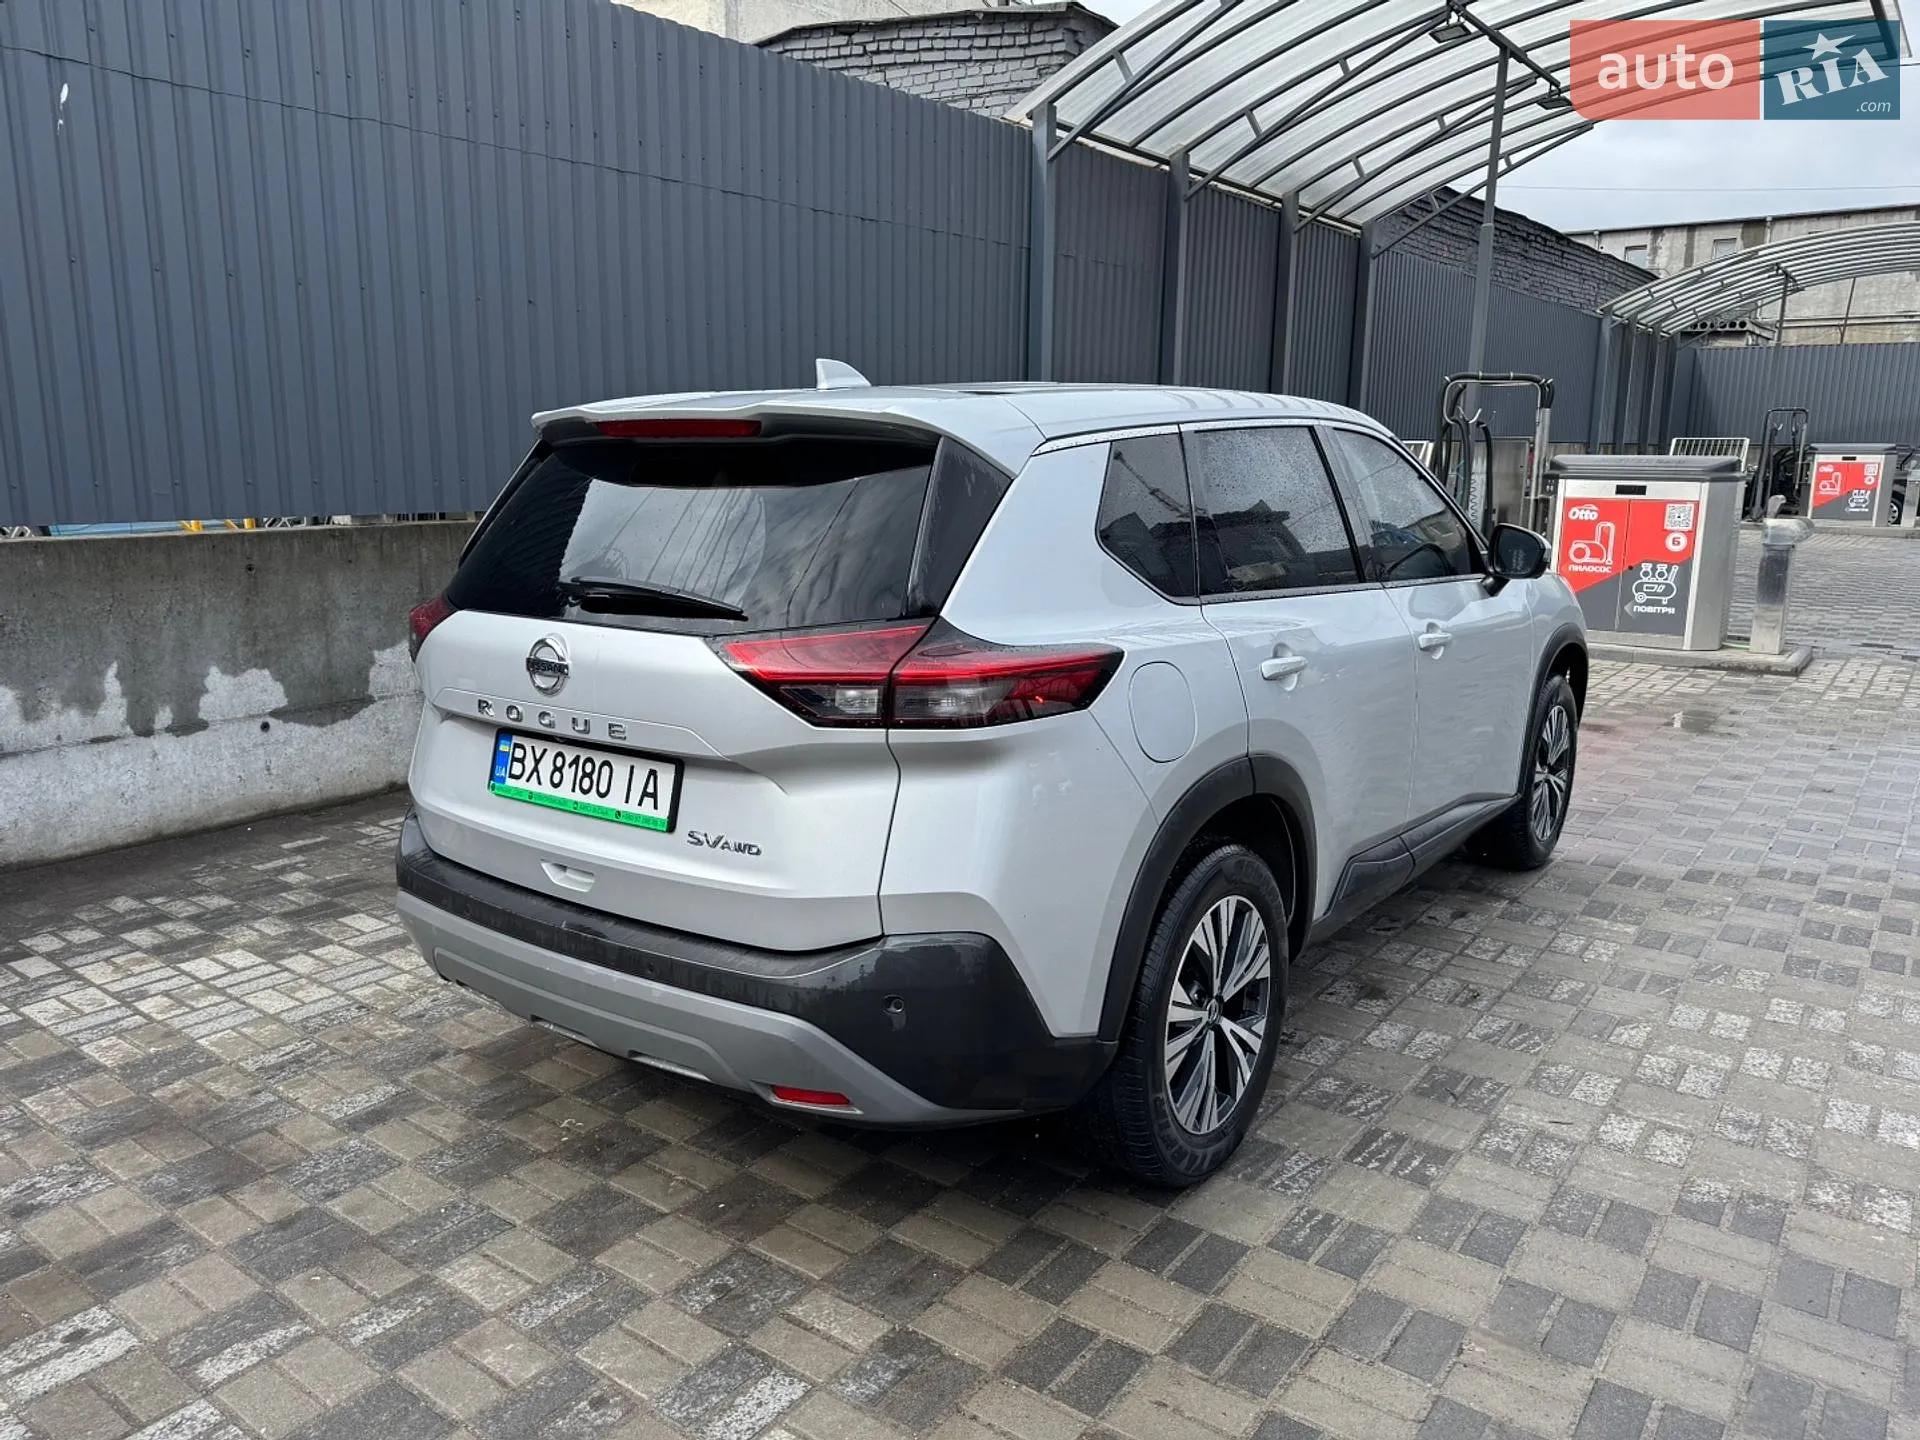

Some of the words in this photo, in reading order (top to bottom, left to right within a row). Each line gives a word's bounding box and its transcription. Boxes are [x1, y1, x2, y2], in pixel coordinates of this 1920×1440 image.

[1568, 507, 1599, 520] Otto
[1568, 564, 1612, 573] ПИЛОСОС
[478, 698, 627, 740] ROGUE
[508, 742, 548, 786] BX
[549, 750, 613, 799] 8180
[624, 765, 659, 810] IA
